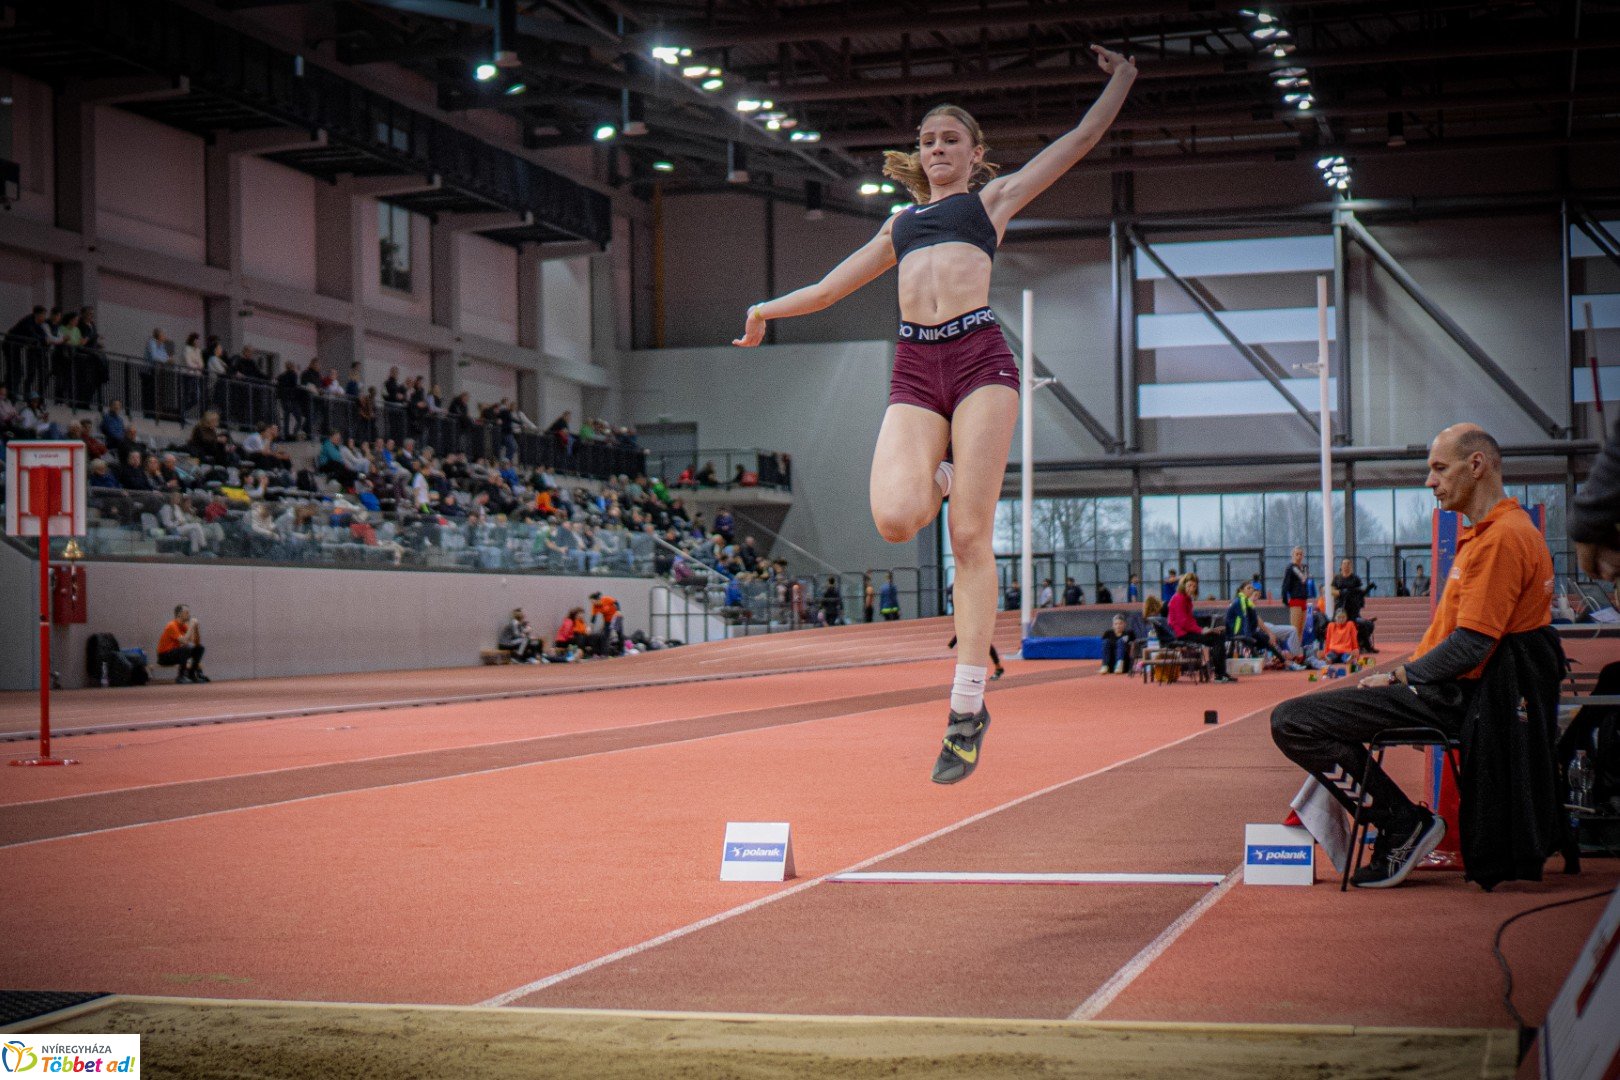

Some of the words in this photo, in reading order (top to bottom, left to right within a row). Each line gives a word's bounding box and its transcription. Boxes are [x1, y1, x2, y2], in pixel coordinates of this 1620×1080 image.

[918, 321, 960, 340] NIKE
[963, 309, 995, 331] PRO
[742, 847, 780, 858] polanik
[1266, 850, 1307, 861] polanik
